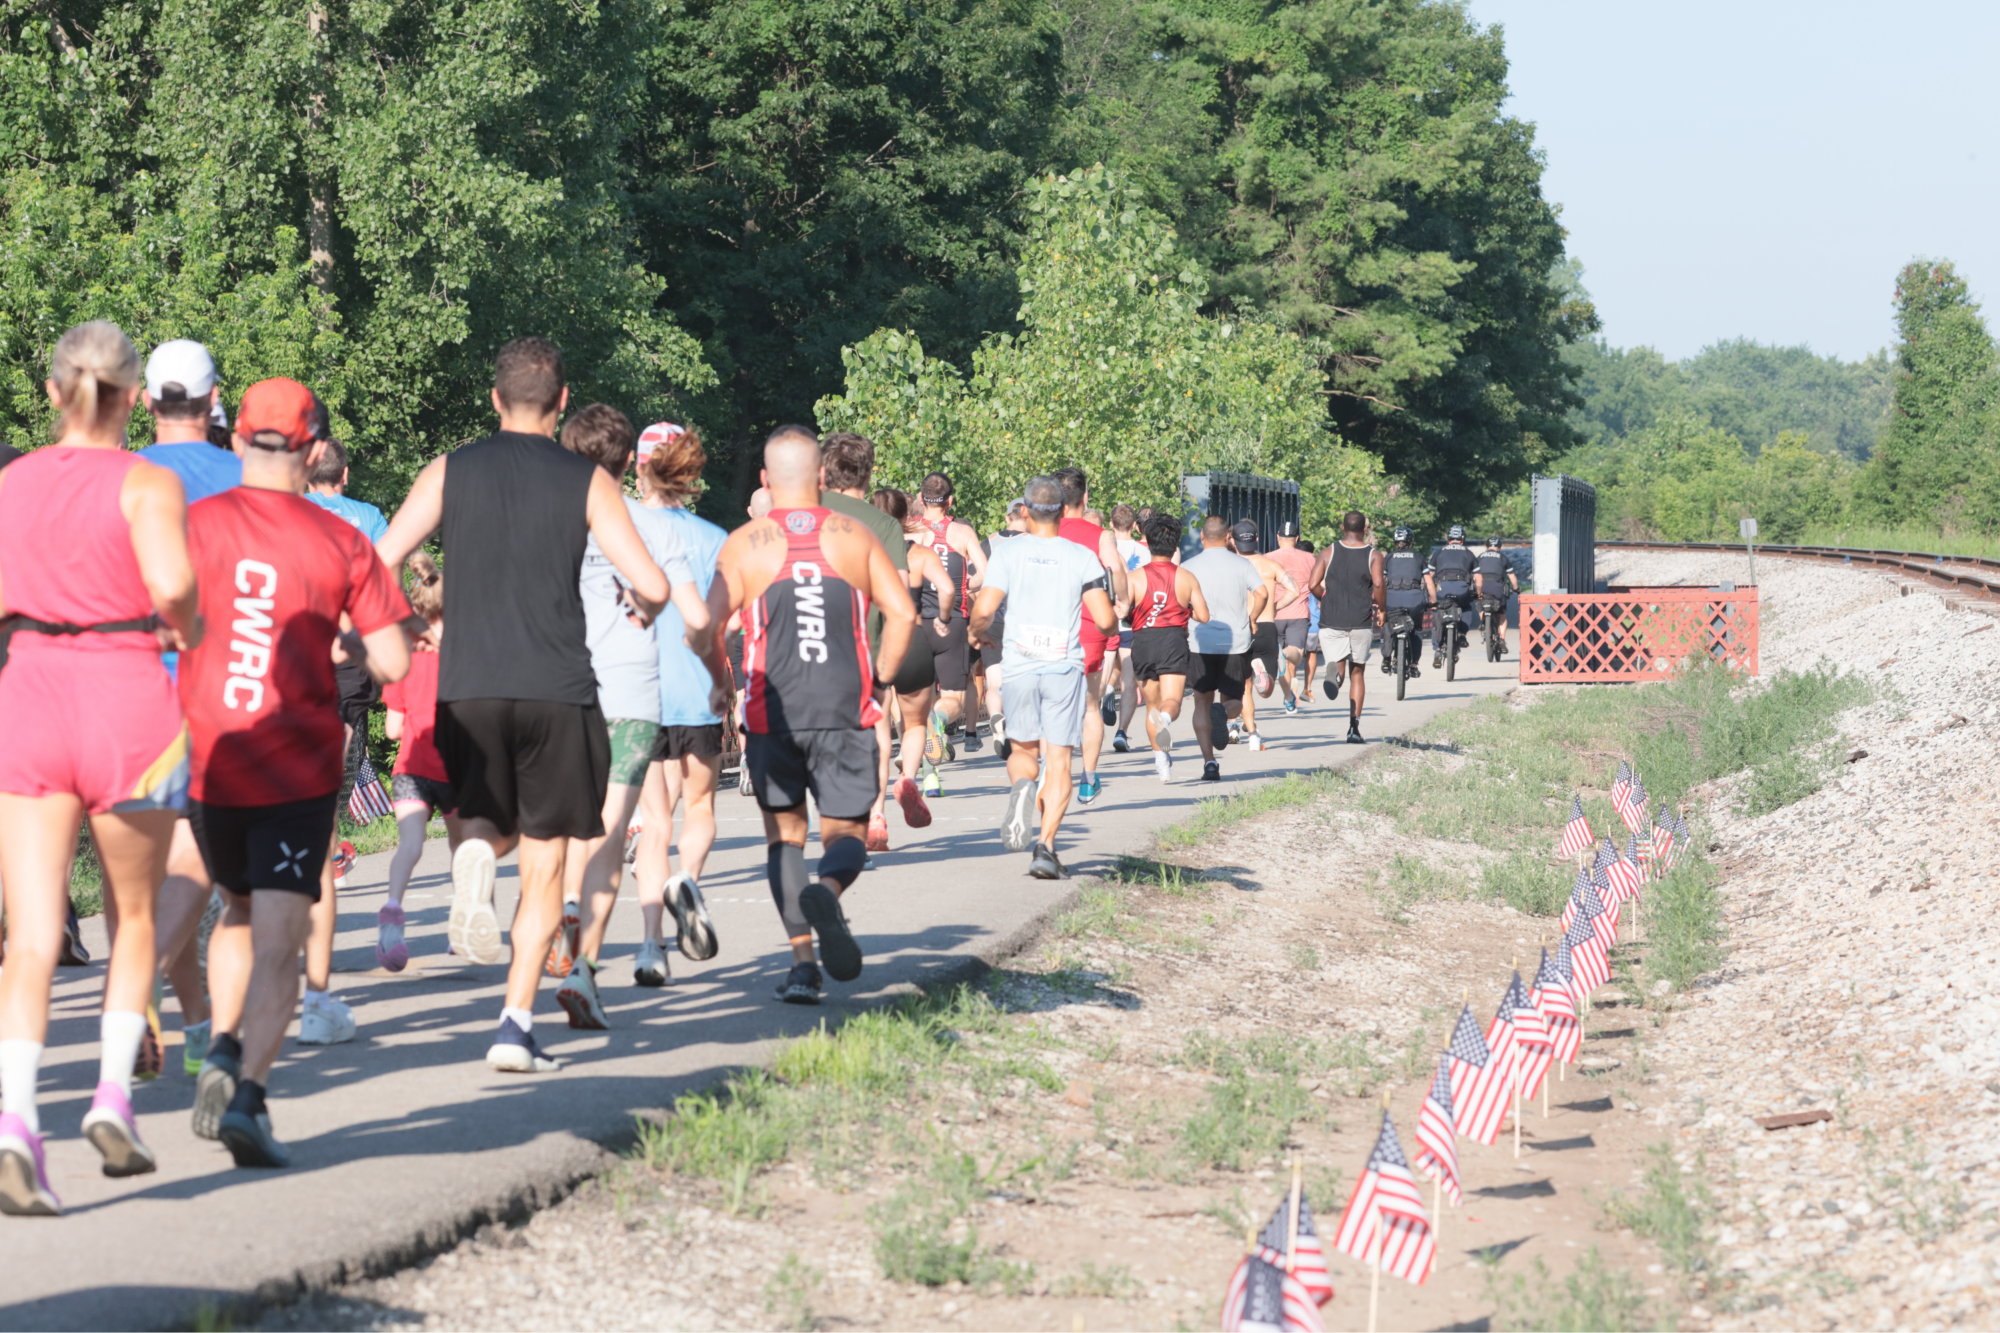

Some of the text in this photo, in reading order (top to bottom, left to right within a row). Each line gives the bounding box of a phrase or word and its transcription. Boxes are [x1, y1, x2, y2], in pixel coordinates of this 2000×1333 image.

[1480, 551, 1501, 559] POLICE
[792, 561, 828, 664] CWRC
[1142, 591, 1168, 628] CWR
[223, 558, 278, 713] CWRC
[1033, 634, 1051, 648] 64
